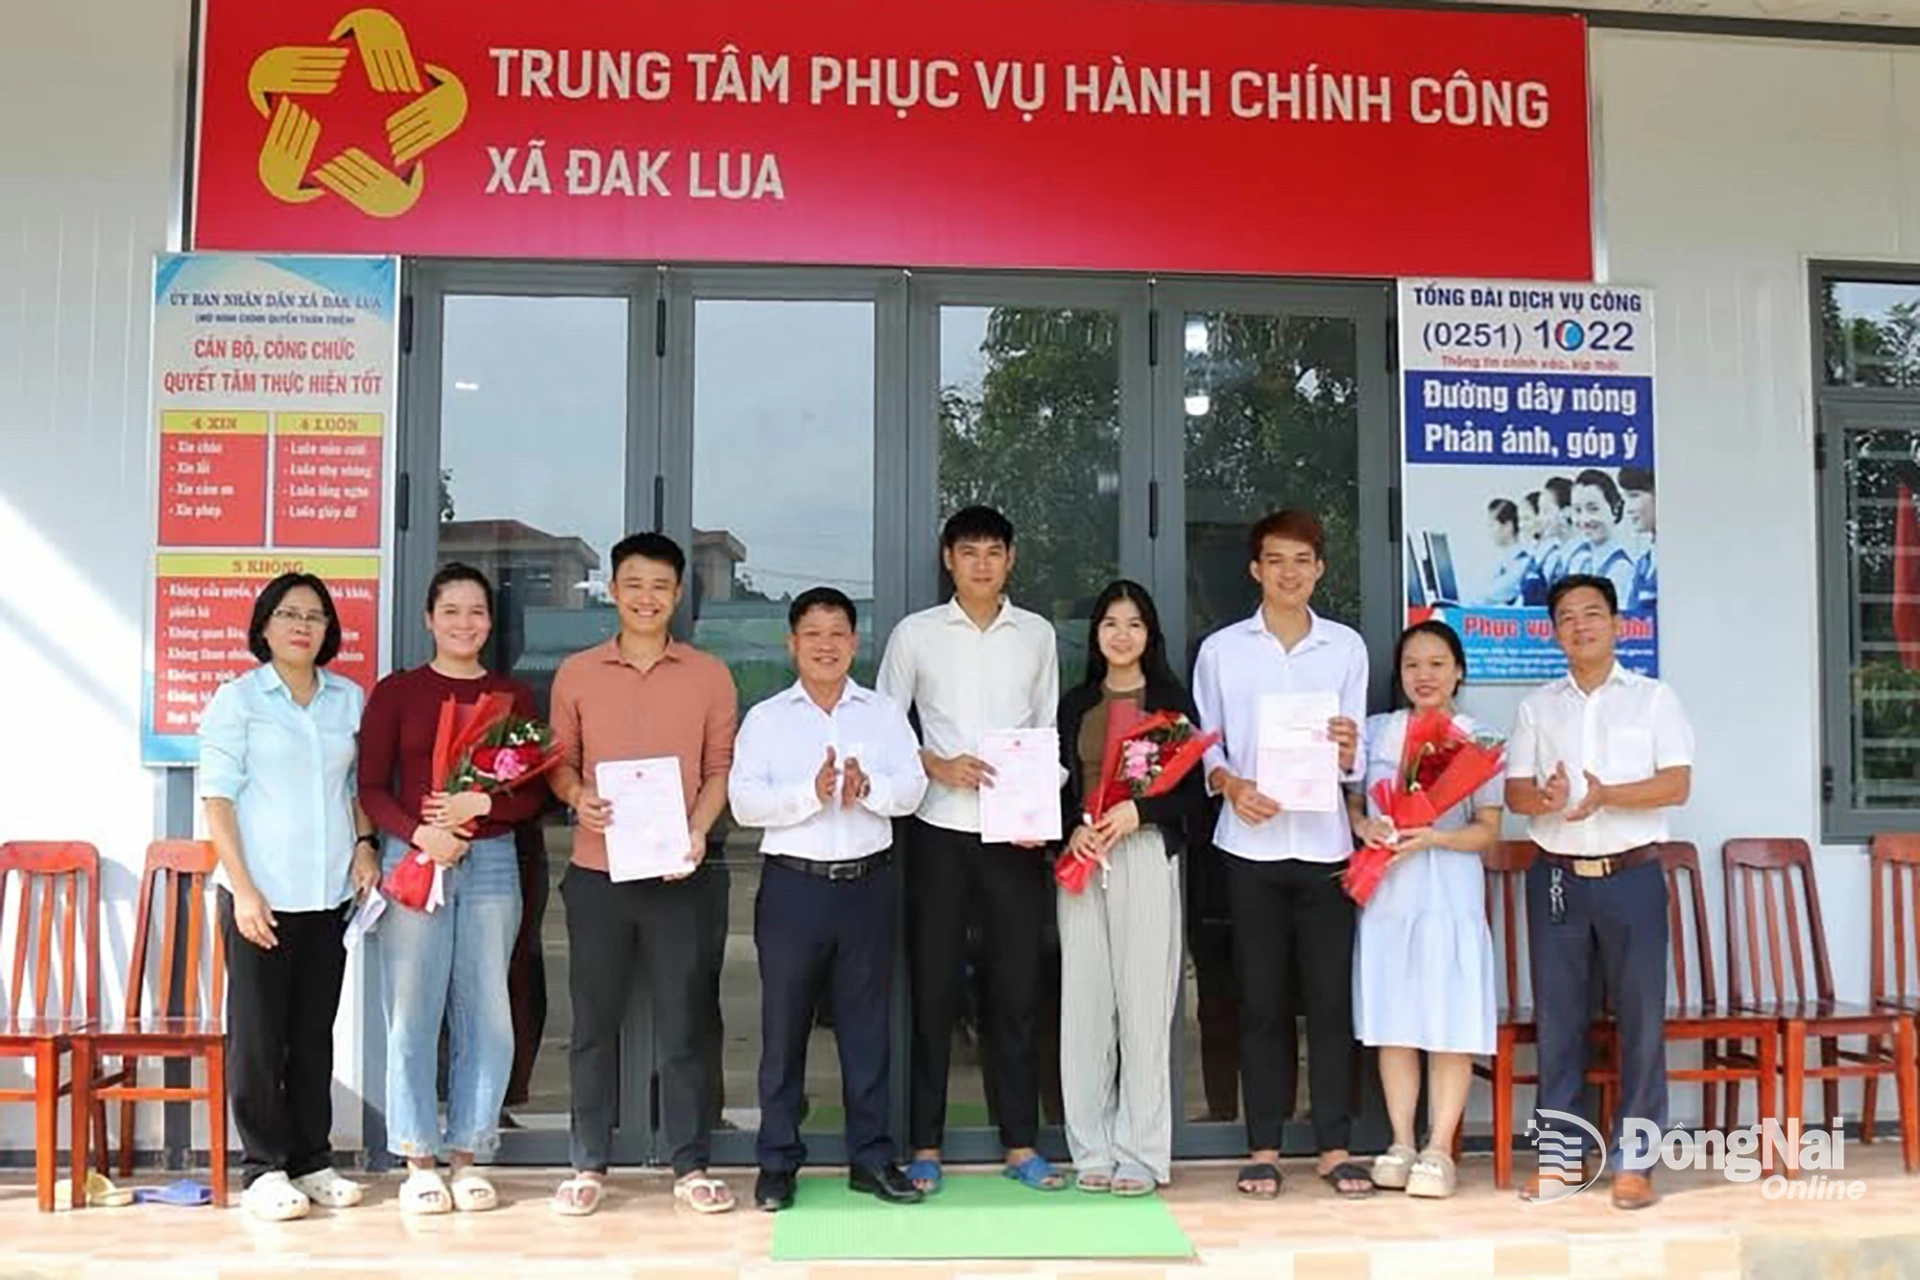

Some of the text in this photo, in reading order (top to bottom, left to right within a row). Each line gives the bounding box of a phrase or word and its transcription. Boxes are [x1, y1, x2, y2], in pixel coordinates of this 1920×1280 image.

[489, 43, 1549, 128] TRUNG TÂM PHỤC VỤ HÀNH CHÍNH CÔNG
[485, 138, 785, 199] XÃ ĐAK LUA
[193, 292, 220, 306] BAN
[223, 290, 262, 307] NHÂN
[265, 290, 295, 308] DÂN
[1414, 283, 1642, 314] TỔNG ĐÀI DỊCH VỤ CÔNG
[195, 334, 355, 363] CÁN BỘ, CÔNG CHỨC
[1423, 322, 1522, 354] (0251)
[164, 365, 382, 396] QUYẾT TÂM THỰC HIỆN TỐT
[1423, 379, 1637, 416] Đường dây nóng
[207, 416, 238, 430] XIN
[315, 415, 359, 432] LUÔN
[1424, 420, 1639, 459] Phản ánh, góp ý
[247, 556, 304, 574] KHÔNG
